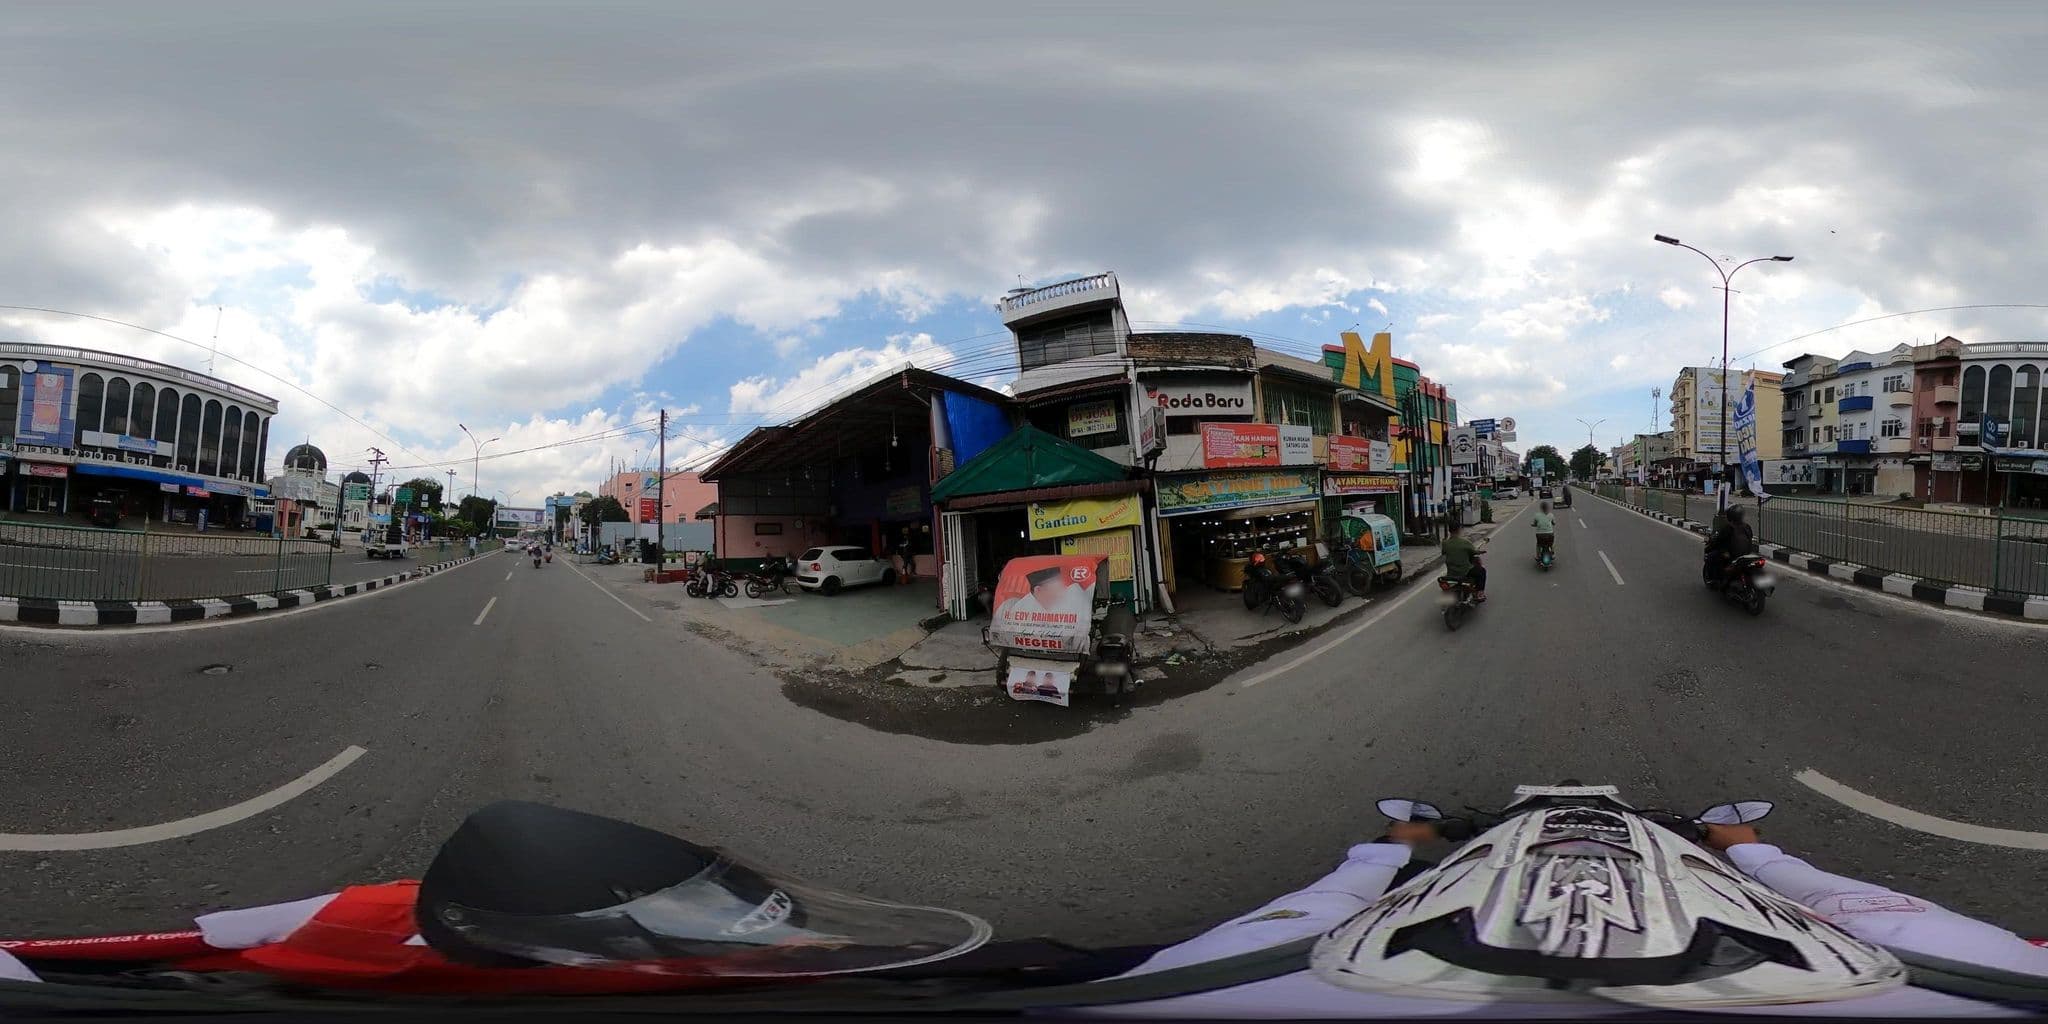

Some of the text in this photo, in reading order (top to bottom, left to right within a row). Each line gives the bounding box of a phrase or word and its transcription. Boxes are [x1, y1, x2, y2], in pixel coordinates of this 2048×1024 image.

[1157, 392, 1244, 409] Roda Baru
[1034, 514, 1088, 530] Gantino
[1014, 636, 1062, 649] NEGERI
